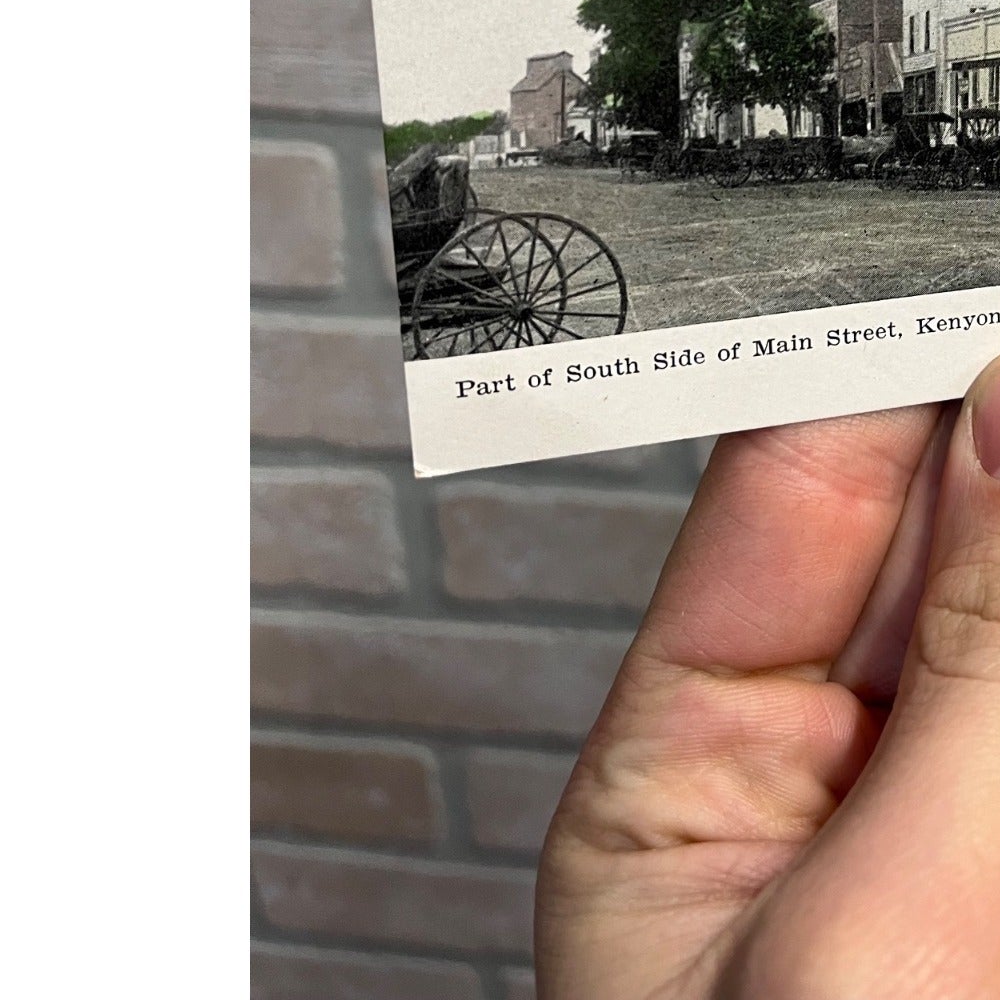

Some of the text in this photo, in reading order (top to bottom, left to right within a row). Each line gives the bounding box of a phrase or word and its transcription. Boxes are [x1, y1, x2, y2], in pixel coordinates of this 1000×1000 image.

[456, 373, 516, 399] Part
[528, 369, 553, 388] of
[566, 358, 640, 383] South
[653, 349, 706, 371] Side
[718, 343, 742, 362] of
[753, 334, 813, 357] Main
[826, 321, 903, 347] Street,
